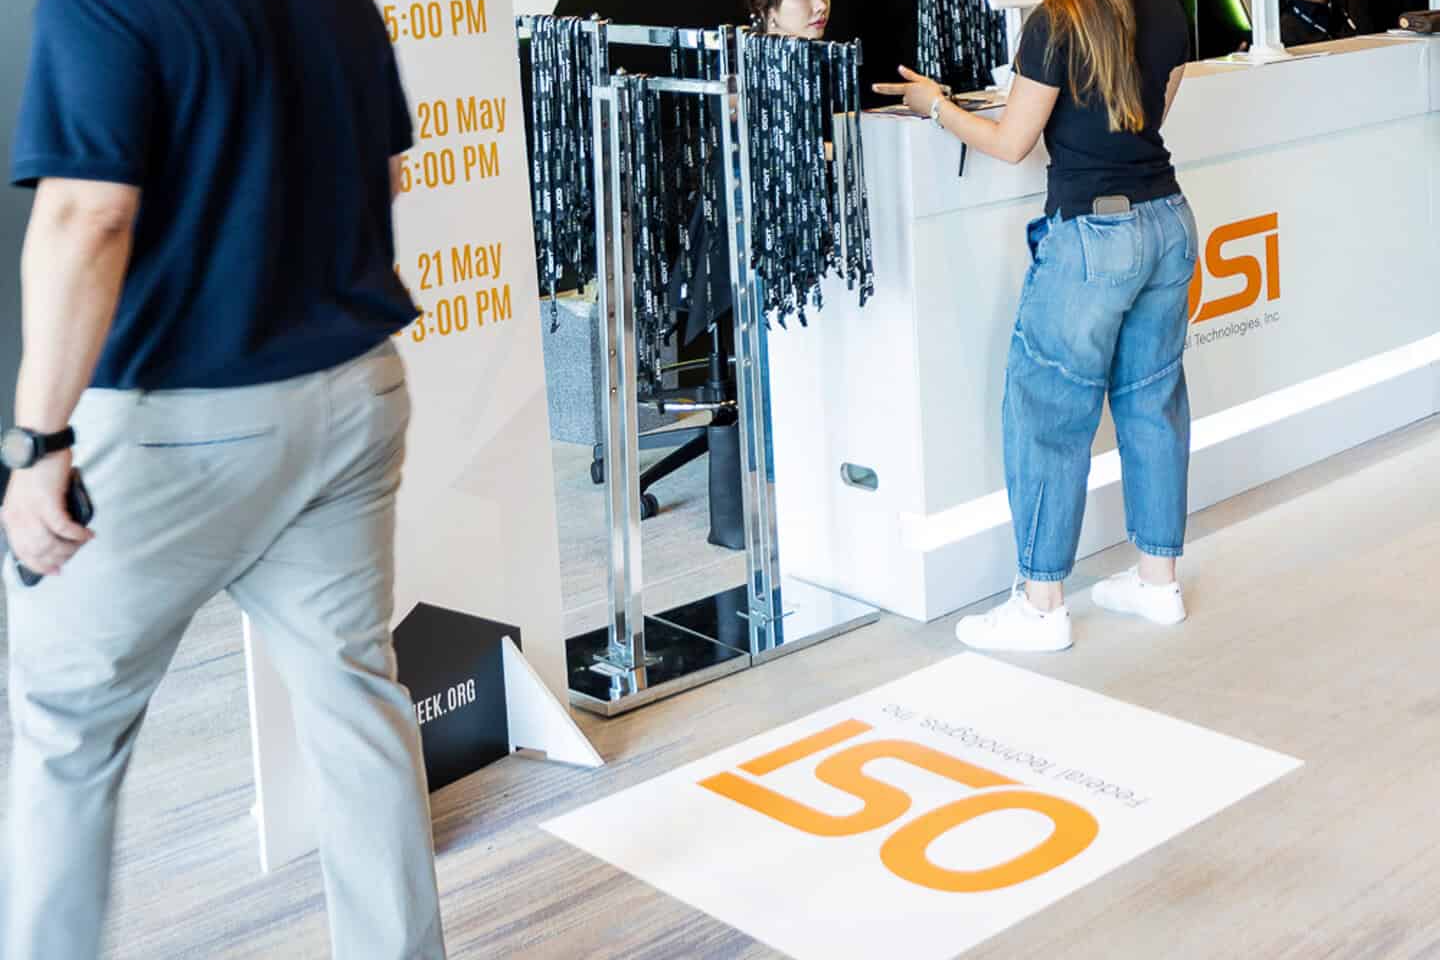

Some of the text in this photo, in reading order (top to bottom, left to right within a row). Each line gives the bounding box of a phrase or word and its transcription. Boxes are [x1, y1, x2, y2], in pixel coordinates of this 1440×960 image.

[384, 2, 443, 43] 5:00
[417, 95, 507, 139] 20 May
[400, 141, 500, 193] 5:00 PM
[418, 242, 502, 291] 21 May
[476, 284, 512, 327] PM
[1195, 318, 1264, 345] Technologies,
[1264, 312, 1280, 324] Inc
[413, 678, 476, 725] EEK.ORG
